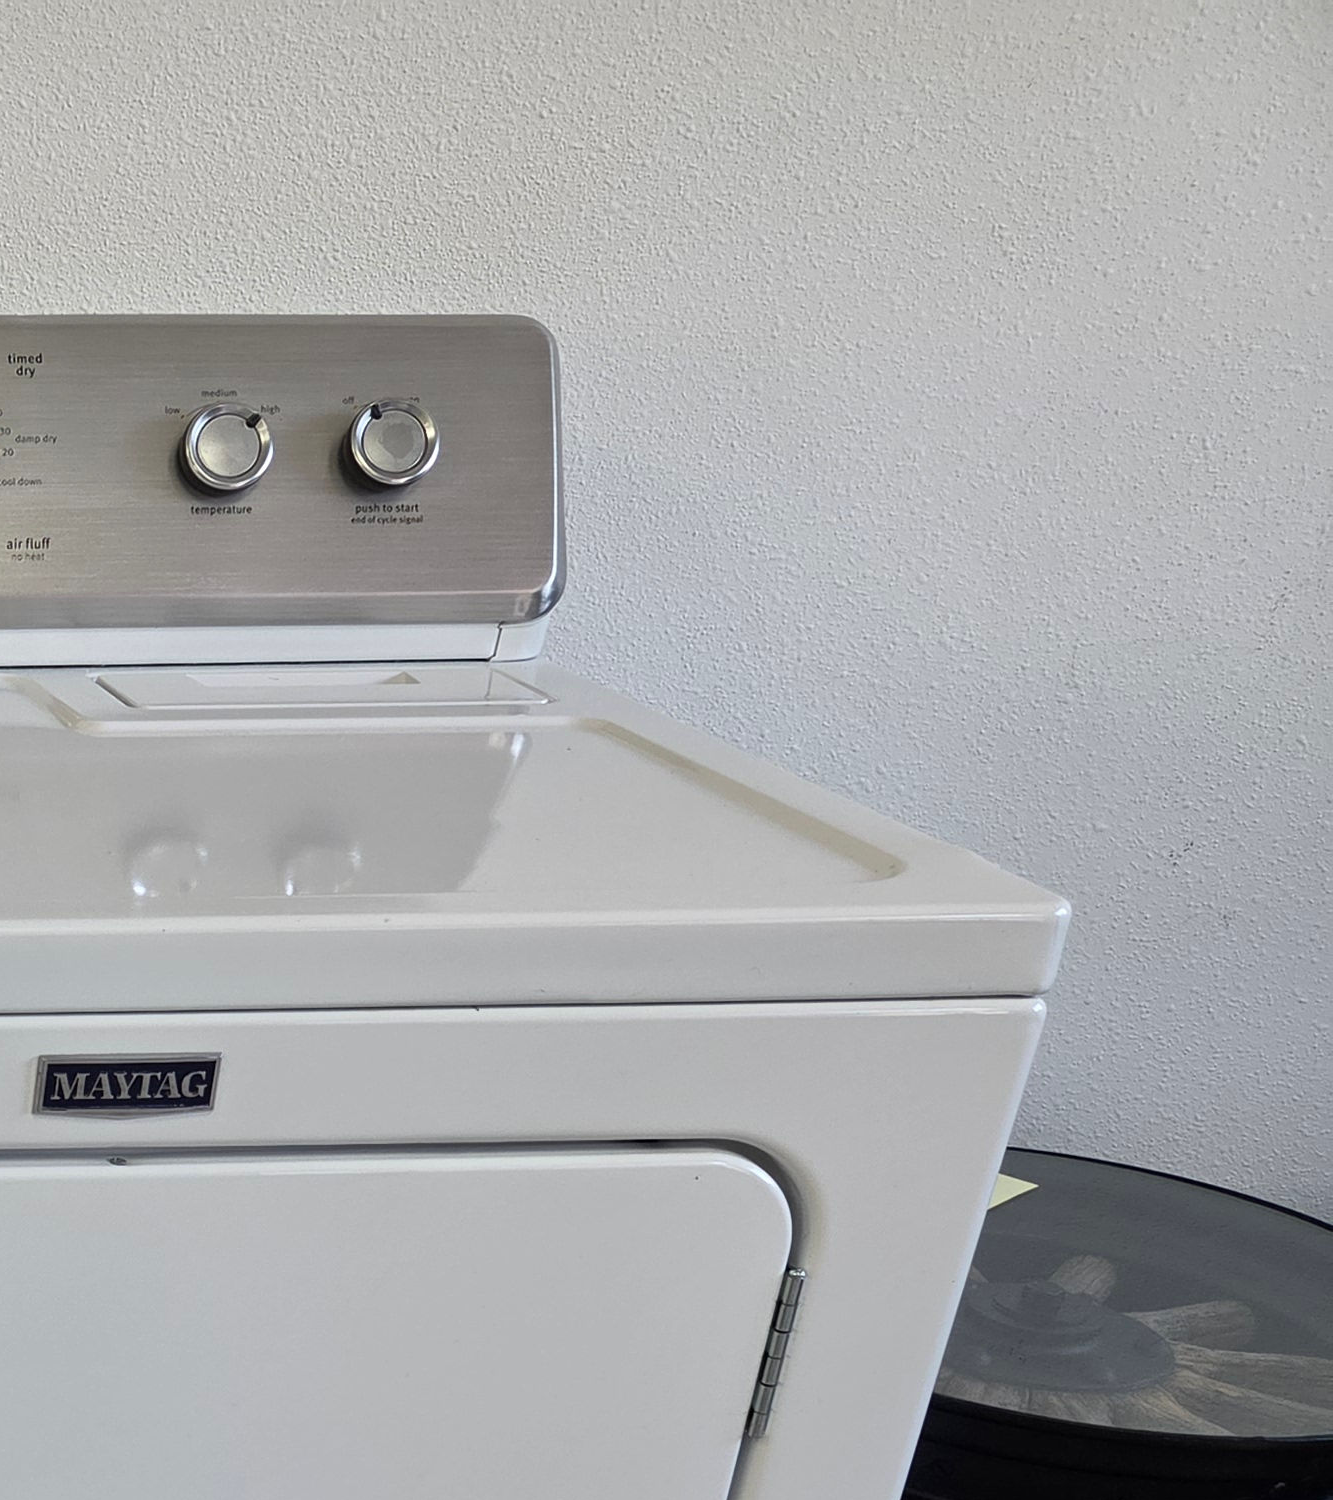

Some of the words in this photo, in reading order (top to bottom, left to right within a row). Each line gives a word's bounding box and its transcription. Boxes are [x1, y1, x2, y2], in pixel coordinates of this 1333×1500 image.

[8, 352, 43, 364] timed
[16, 366, 35, 378] dry
[201, 389, 237, 398] medium
[342, 396, 355, 404] off
[165, 406, 181, 414] low
[260, 405, 281, 415] high
[0, 427, 11, 435] 30
[15, 434, 41, 444] damp
[42, 434, 58, 444] dry
[2, 449, 14, 457] 20
[18, 478, 42, 486] down
[191, 505, 252, 516] temperature
[355, 503, 380, 515] push
[382, 504, 393, 513] to
[395, 504, 419, 513] start
[351, 516, 366, 524] end
[367, 516, 376, 524] of
[377, 516, 397, 525] cycle
[399, 515, 423, 525] signal
[6, 538, 23, 550] air
[25, 537, 51, 550] fluff
[25, 553, 45, 561] heat
[50, 1071, 208, 1100] MAYTAG
